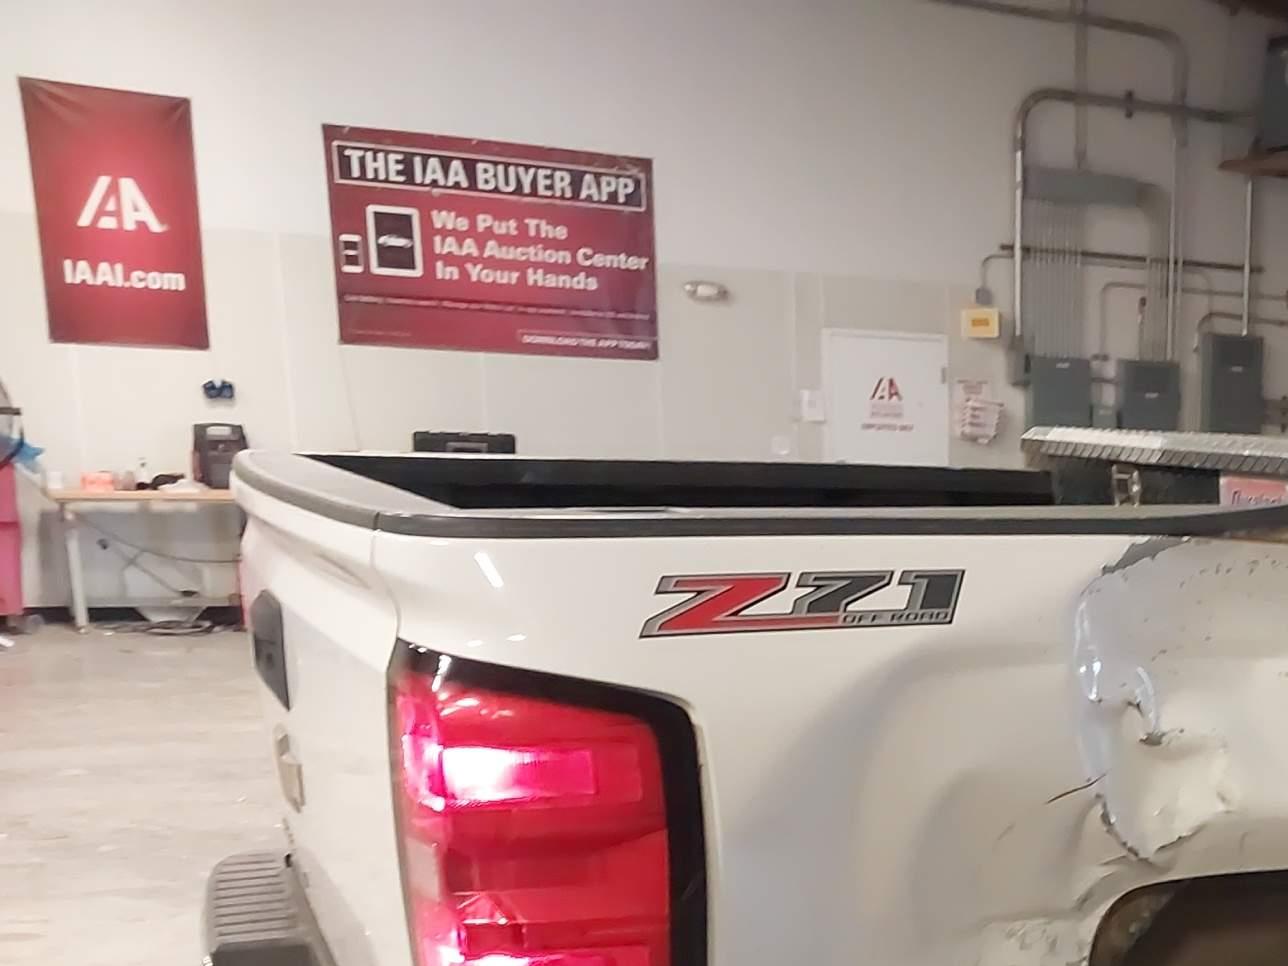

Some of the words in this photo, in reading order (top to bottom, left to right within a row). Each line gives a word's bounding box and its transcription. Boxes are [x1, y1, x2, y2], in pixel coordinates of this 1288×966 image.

[344, 148, 407, 182] THE
[413, 155, 470, 189] IAA
[476, 161, 573, 198] BUYER
[579, 173, 636, 203] APP
[431, 210, 469, 231] We
[476, 214, 518, 236] Put
[524, 218, 568, 240] The
[433, 235, 479, 257] IAA
[483, 240, 571, 264] Auction
[576, 247, 650, 270] Center
[63, 258, 186, 291] IAAI.com
[435, 260, 460, 280] In
[464, 263, 520, 284] Your
[526, 268, 598, 291] Hands
[639, 570, 966, 639] Z71
[842, 613, 879, 624] OFF
[889, 611, 949, 623] ROAD
